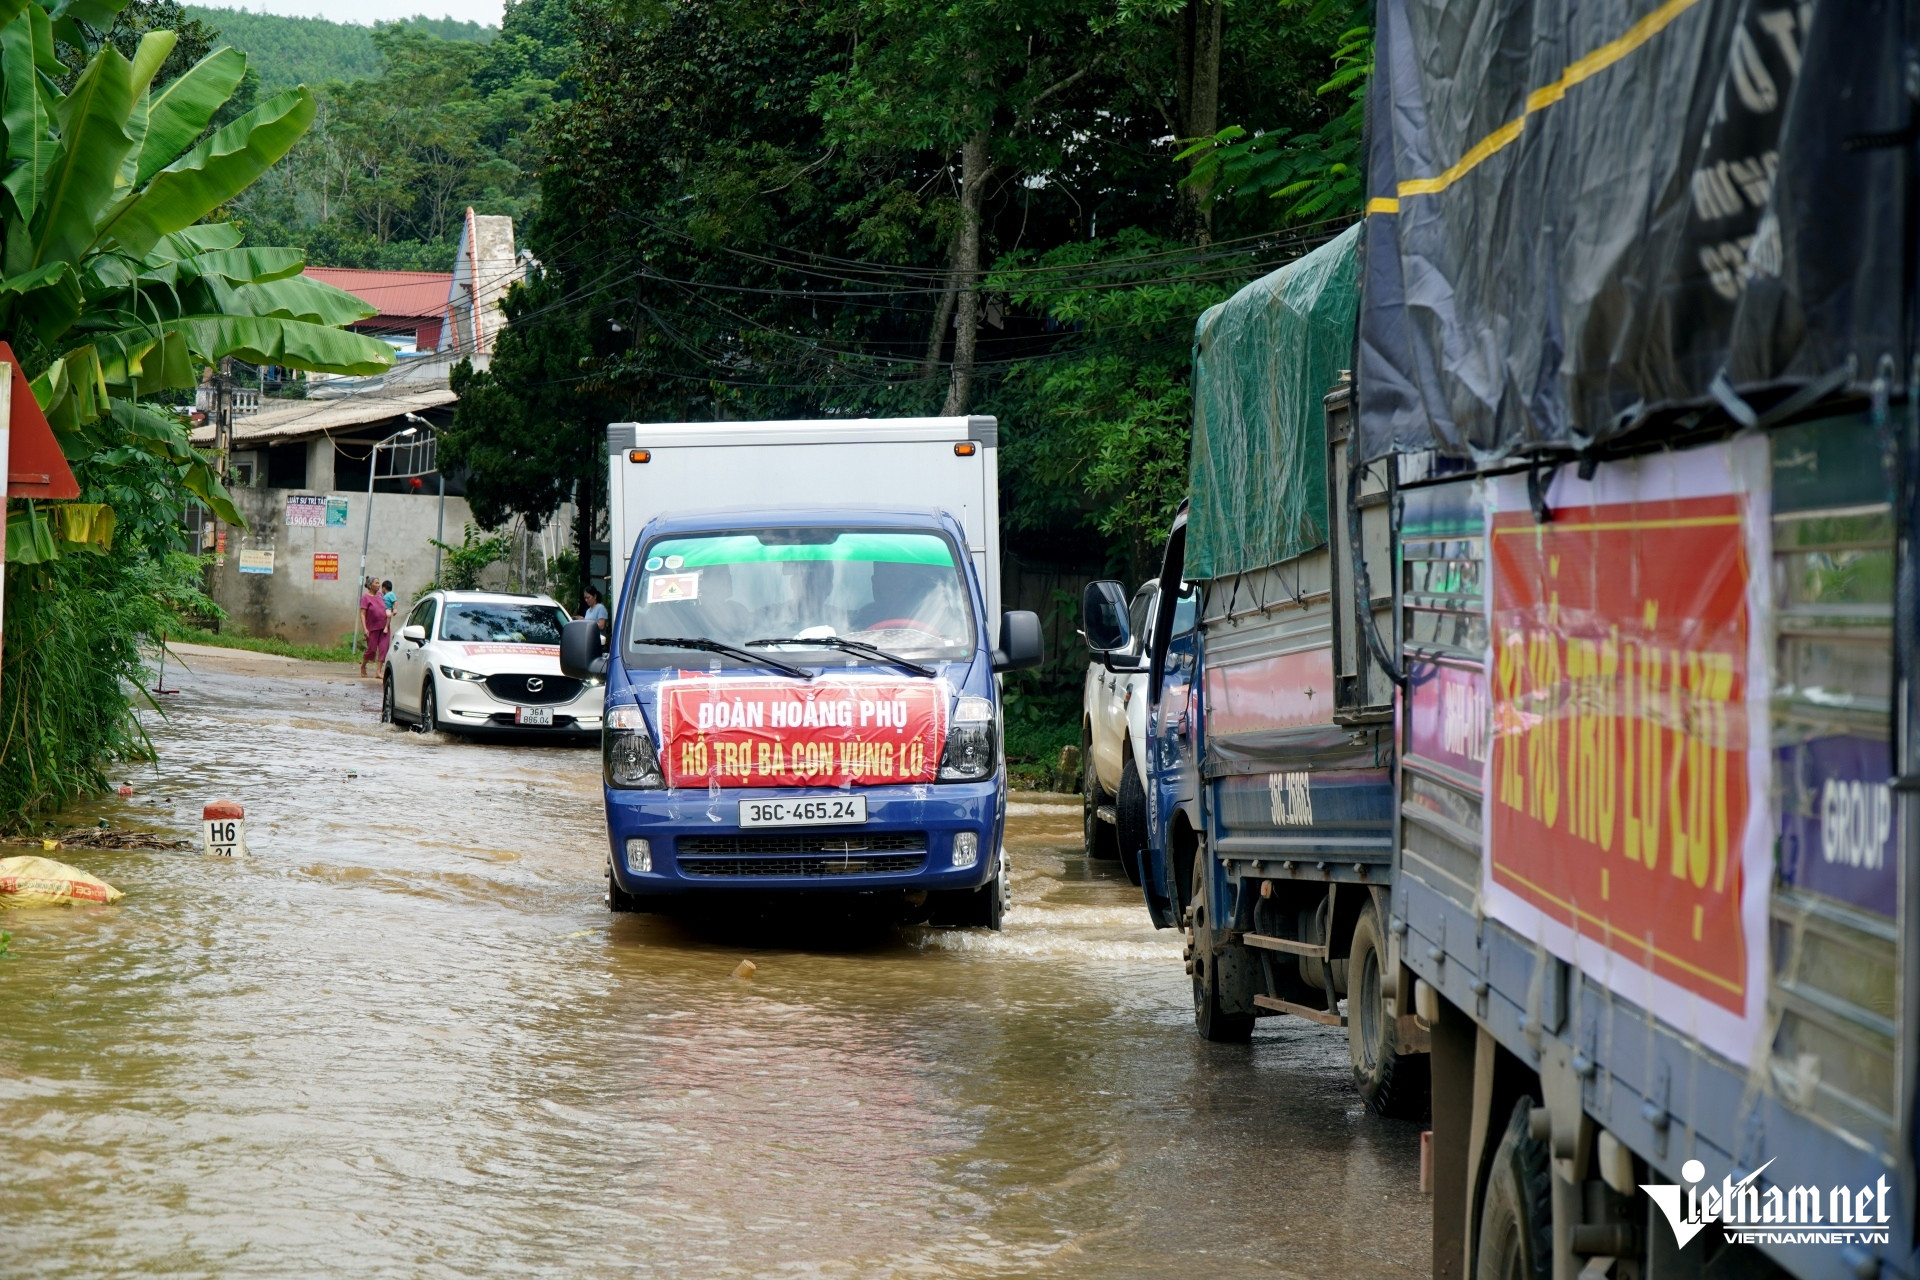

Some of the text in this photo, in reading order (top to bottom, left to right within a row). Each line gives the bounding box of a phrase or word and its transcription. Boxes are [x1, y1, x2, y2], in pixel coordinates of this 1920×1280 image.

[530, 708, 543, 716] 36A
[698, 697, 763, 729] ĐOÀN
[860, 700, 907, 734] PHỤ
[682, 730, 923, 784] HỖ TRỢ BÀ CON VÙNG LŨ
[1567, 624, 1618, 900] TRỢ
[1670, 650, 1733, 941] LỤT
[750, 801, 855, 821] 36C-465.24
[1822, 778, 1891, 871] GROUP
[211, 822, 236, 842] H6
